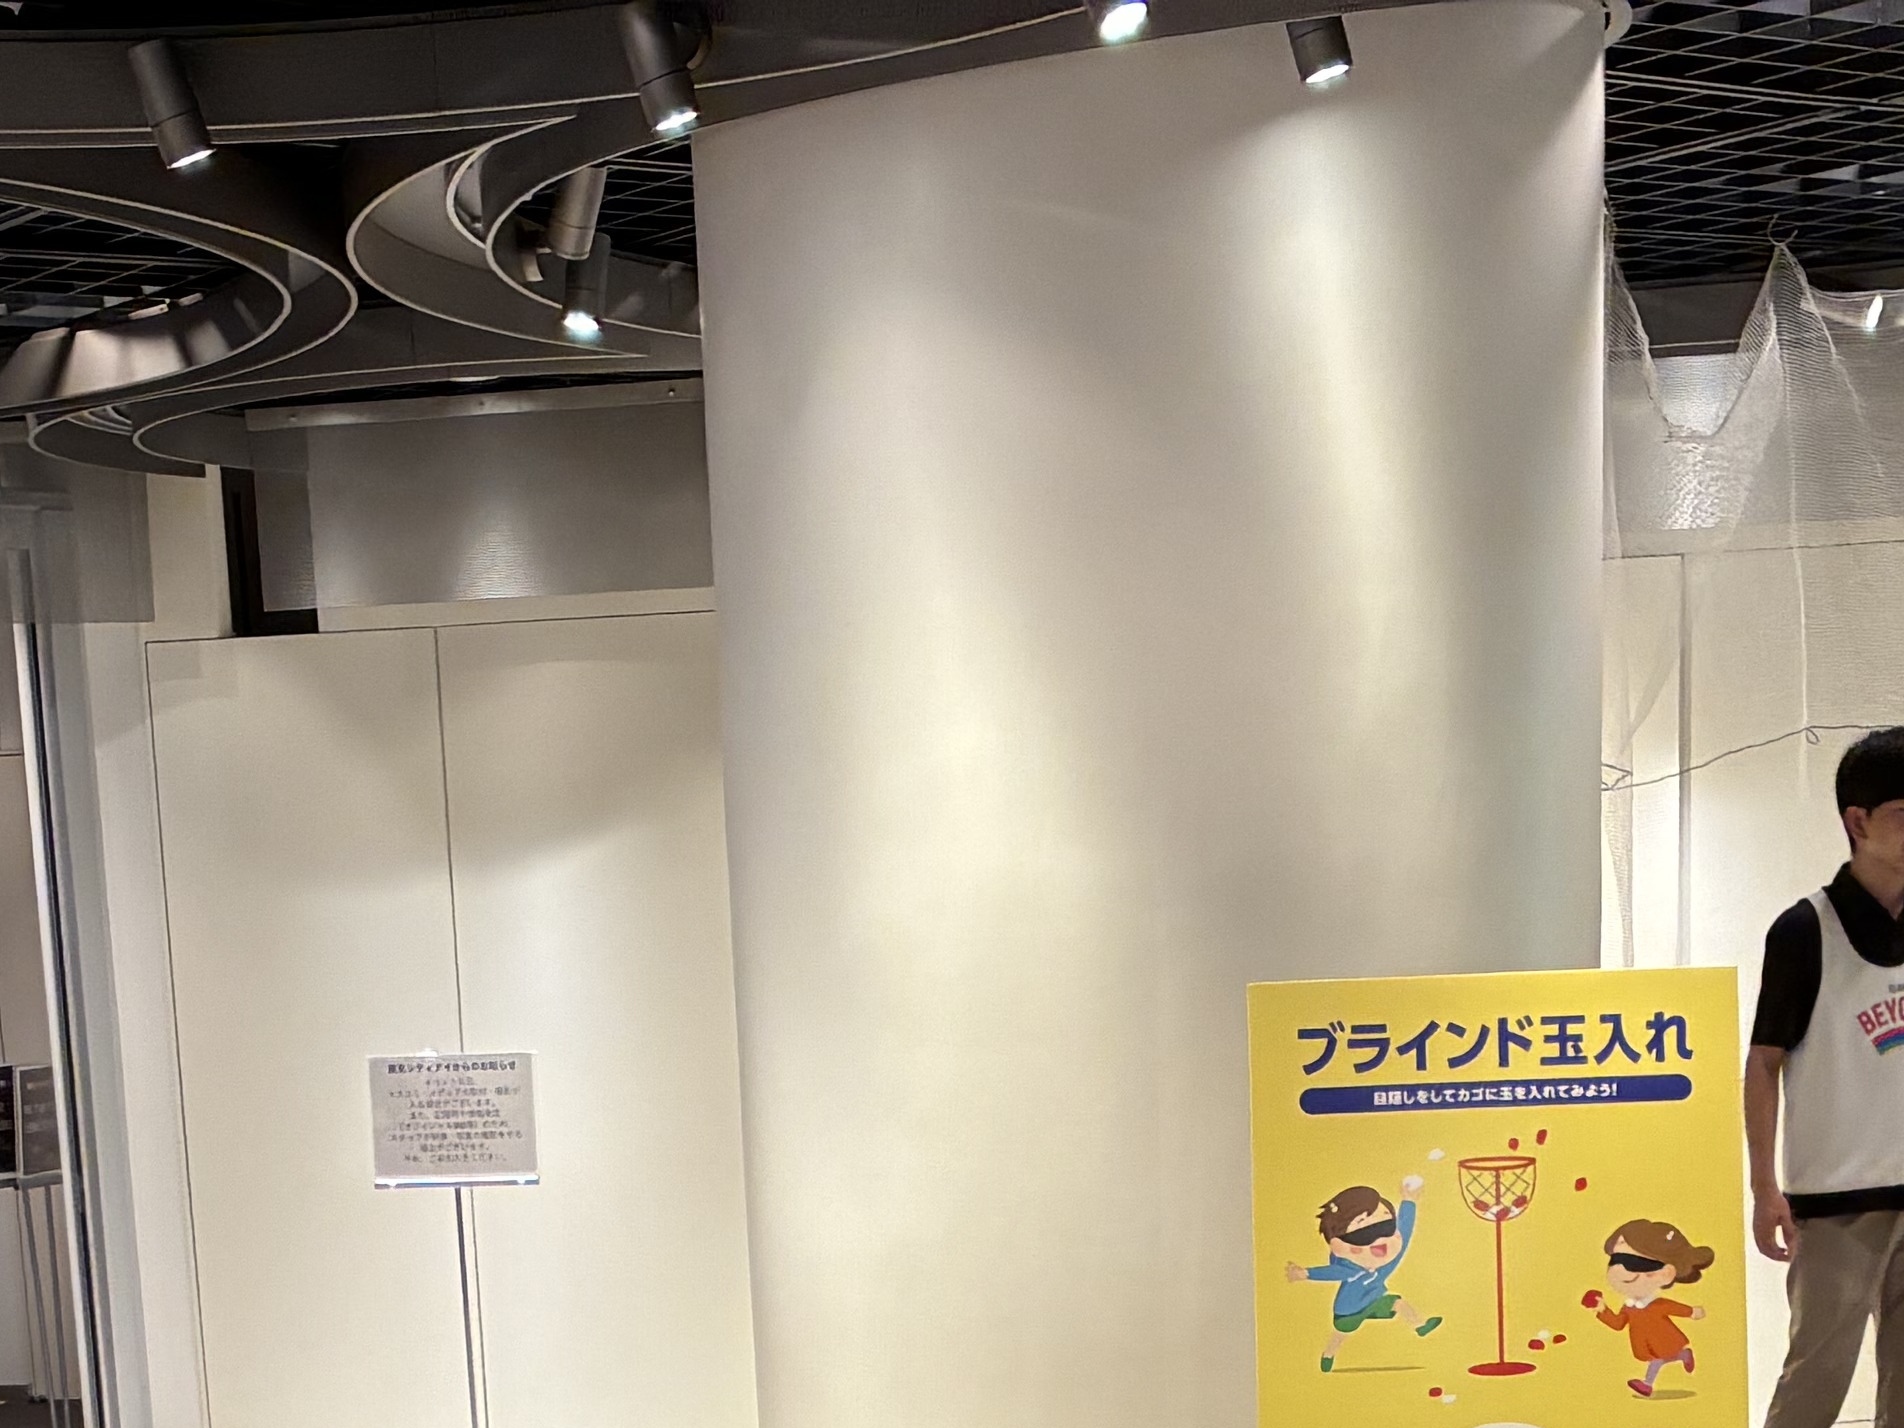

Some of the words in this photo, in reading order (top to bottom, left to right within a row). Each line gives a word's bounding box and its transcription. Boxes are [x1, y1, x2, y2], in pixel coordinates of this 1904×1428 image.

[1297, 1011, 1694, 1077] ブラインド玉入れ
